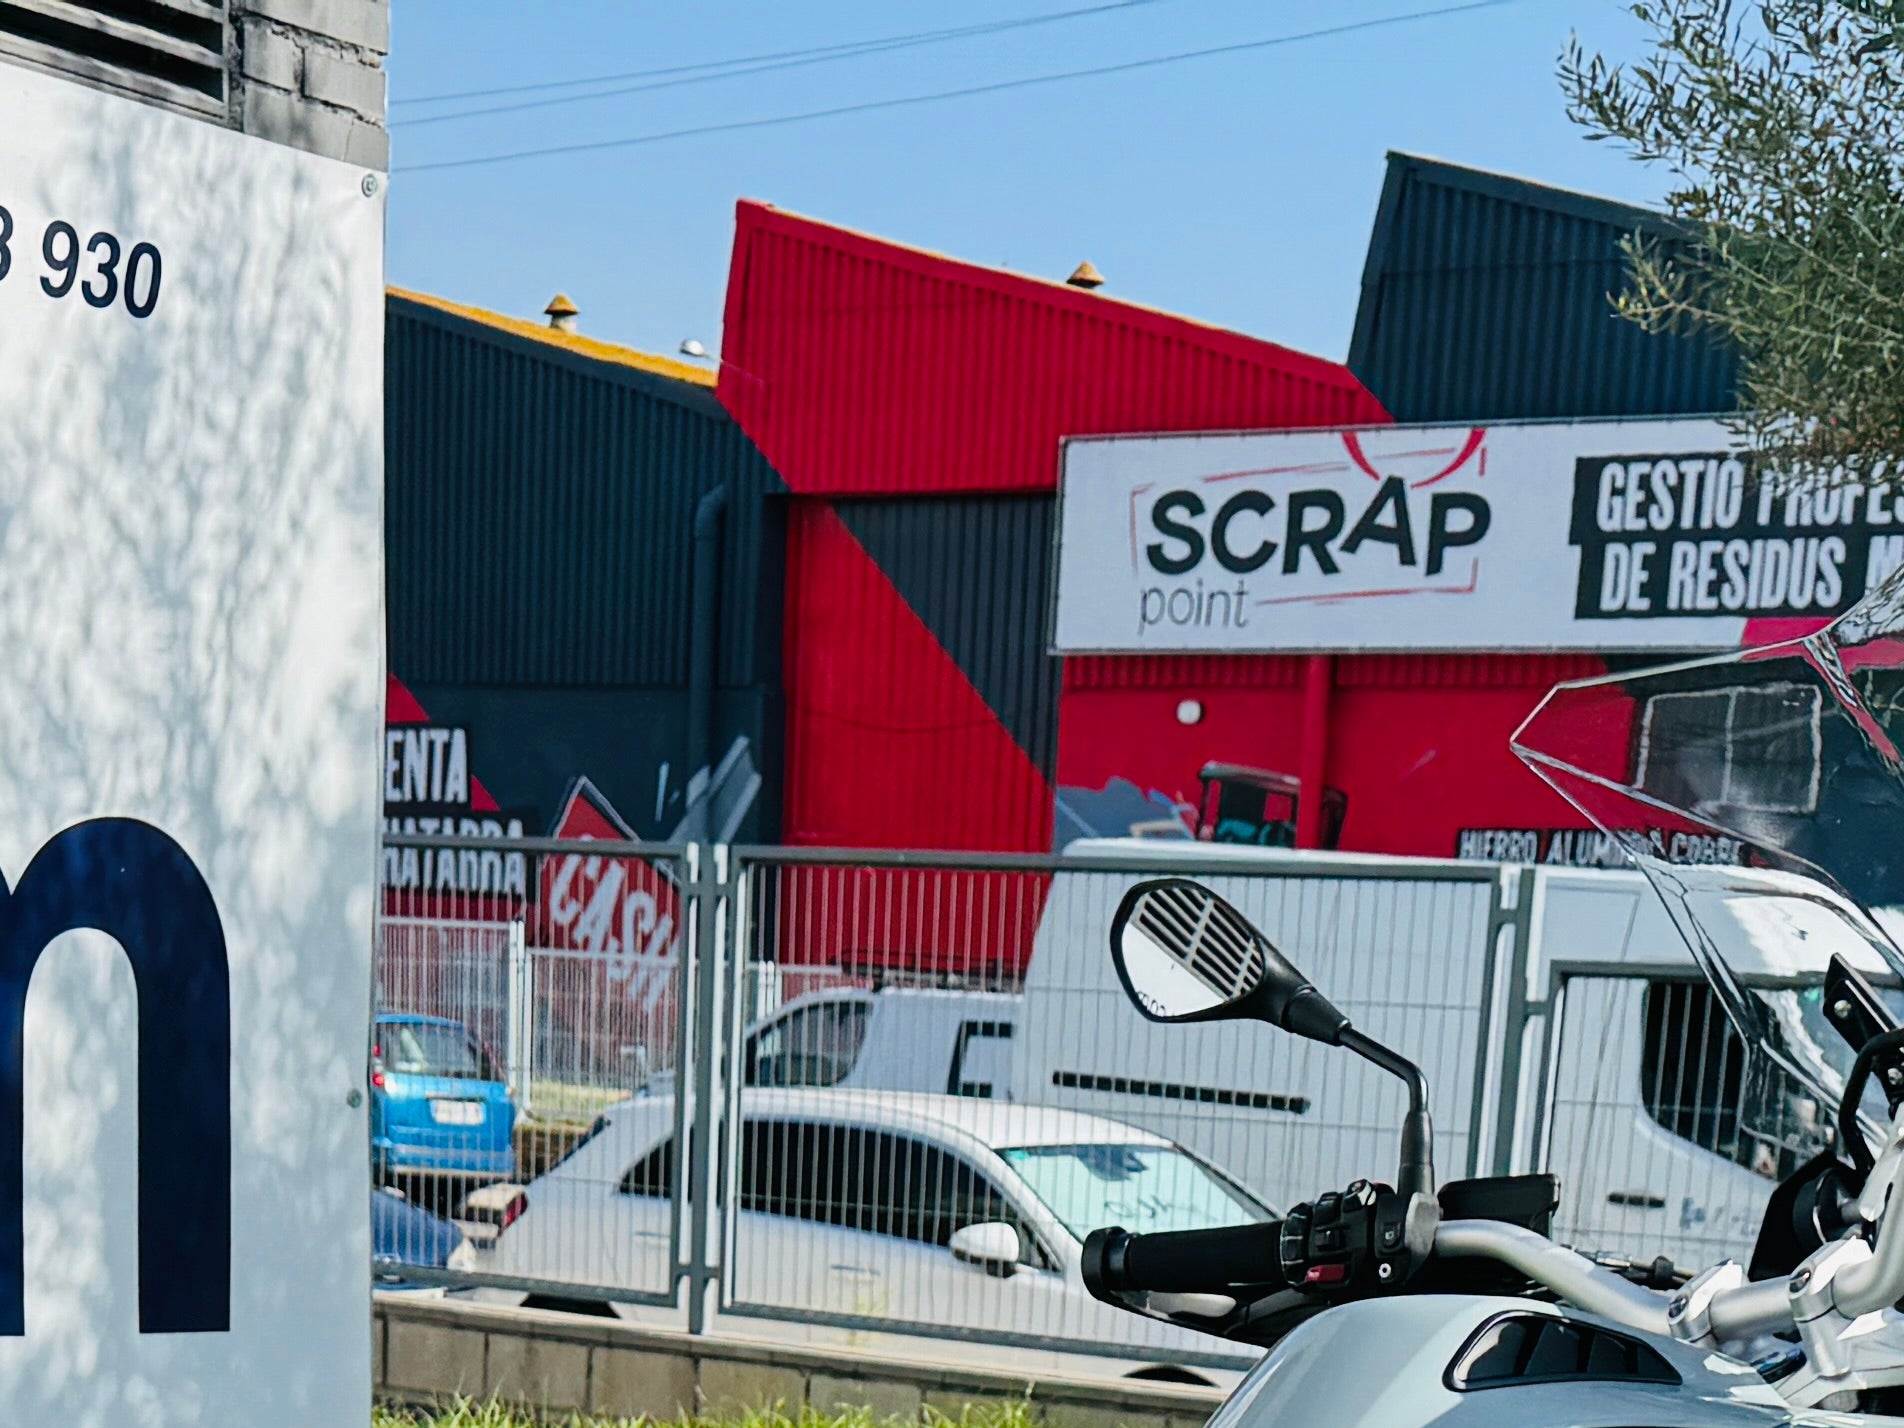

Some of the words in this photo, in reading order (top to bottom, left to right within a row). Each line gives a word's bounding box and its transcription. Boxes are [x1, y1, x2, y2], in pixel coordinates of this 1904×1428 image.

[39, 219, 163, 320] 930
[1146, 474, 1492, 577] SCRAP
[1136, 578, 1250, 637] point
[1598, 540, 1658, 612] DE
[1666, 534, 1846, 612] RESIDUS
[384, 727, 470, 804] ENTA
